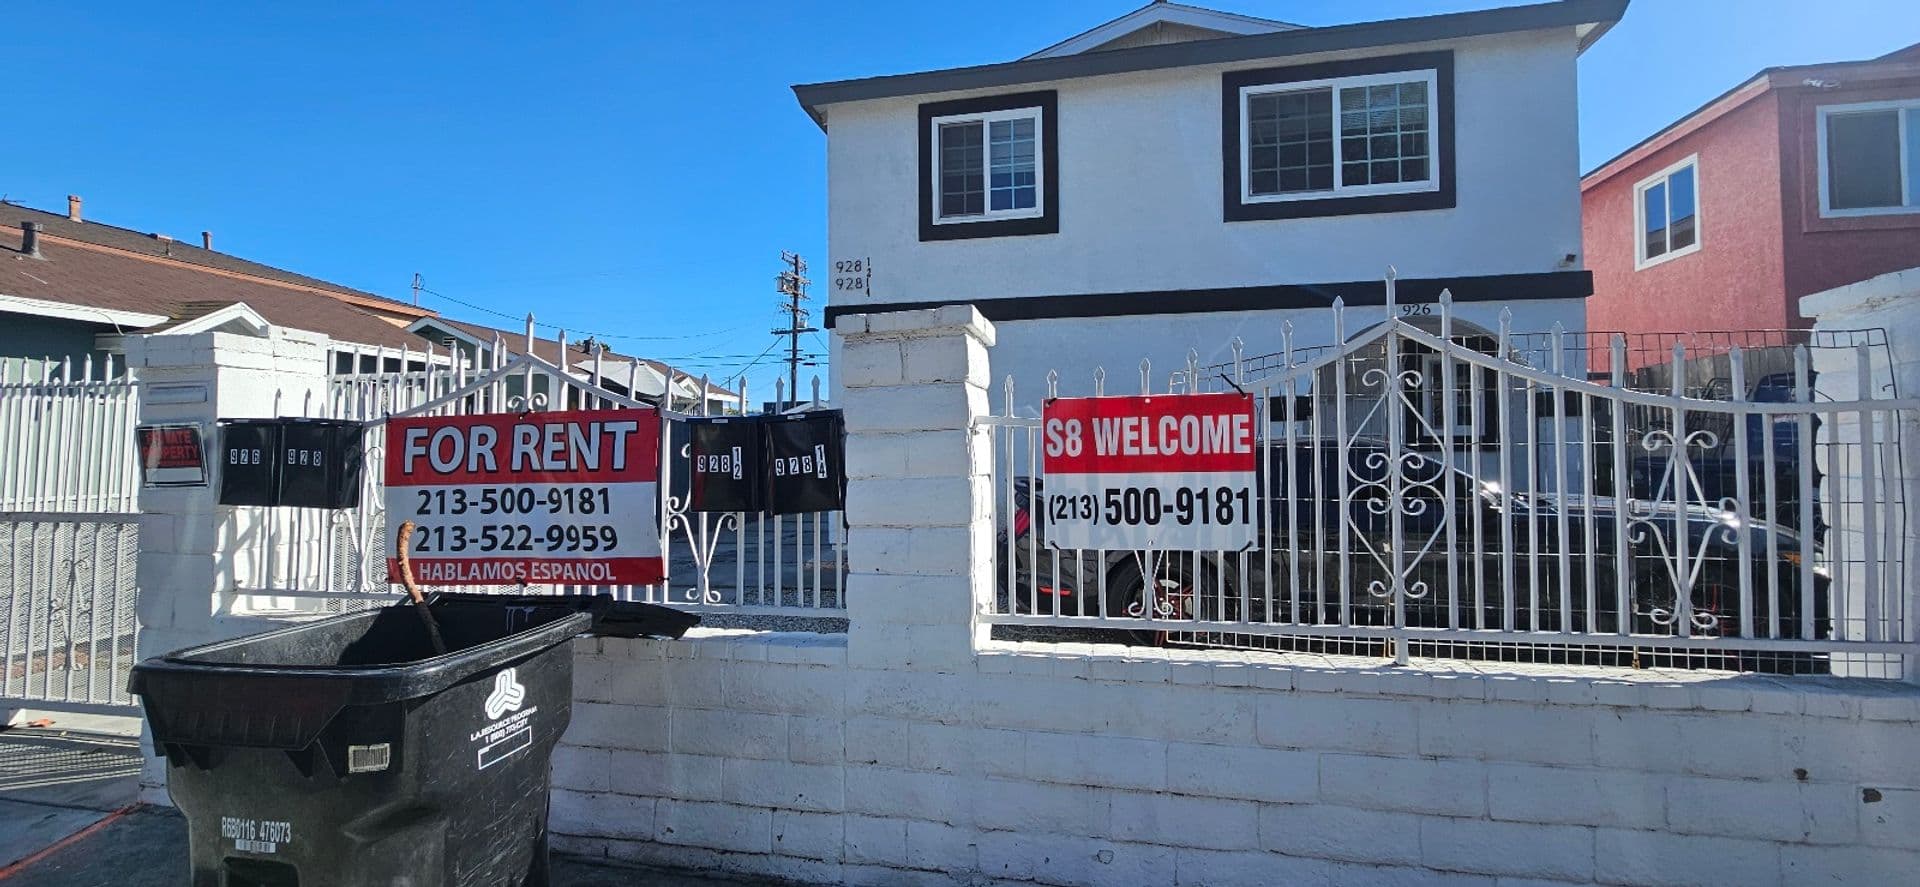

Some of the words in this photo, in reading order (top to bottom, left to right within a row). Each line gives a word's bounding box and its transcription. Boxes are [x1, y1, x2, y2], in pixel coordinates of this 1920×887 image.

[836, 260, 862, 273] 928
[836, 278, 863, 290] 928
[1402, 303, 1431, 315] 926
[145, 430, 192, 445] PVATE
[1046, 418, 1083, 457] S8
[1092, 414, 1251, 456] WELCOME
[143, 445, 198, 459] PPERTY
[231, 449, 260, 464] 926
[404, 424, 498, 475] FOR
[511, 420, 639, 473] RENT
[289, 449, 321, 466] 928
[698, 455, 730, 473] 928
[776, 456, 813, 476] 928
[416, 487, 611, 516] 213-500-9181
[1050, 494, 1099, 525] (213)
[1105, 487, 1249, 526] 500-9181
[415, 524, 618, 552] 213-522-9959
[419, 561, 527, 581] HABLAMOS
[260, 821, 291, 843] 476073
